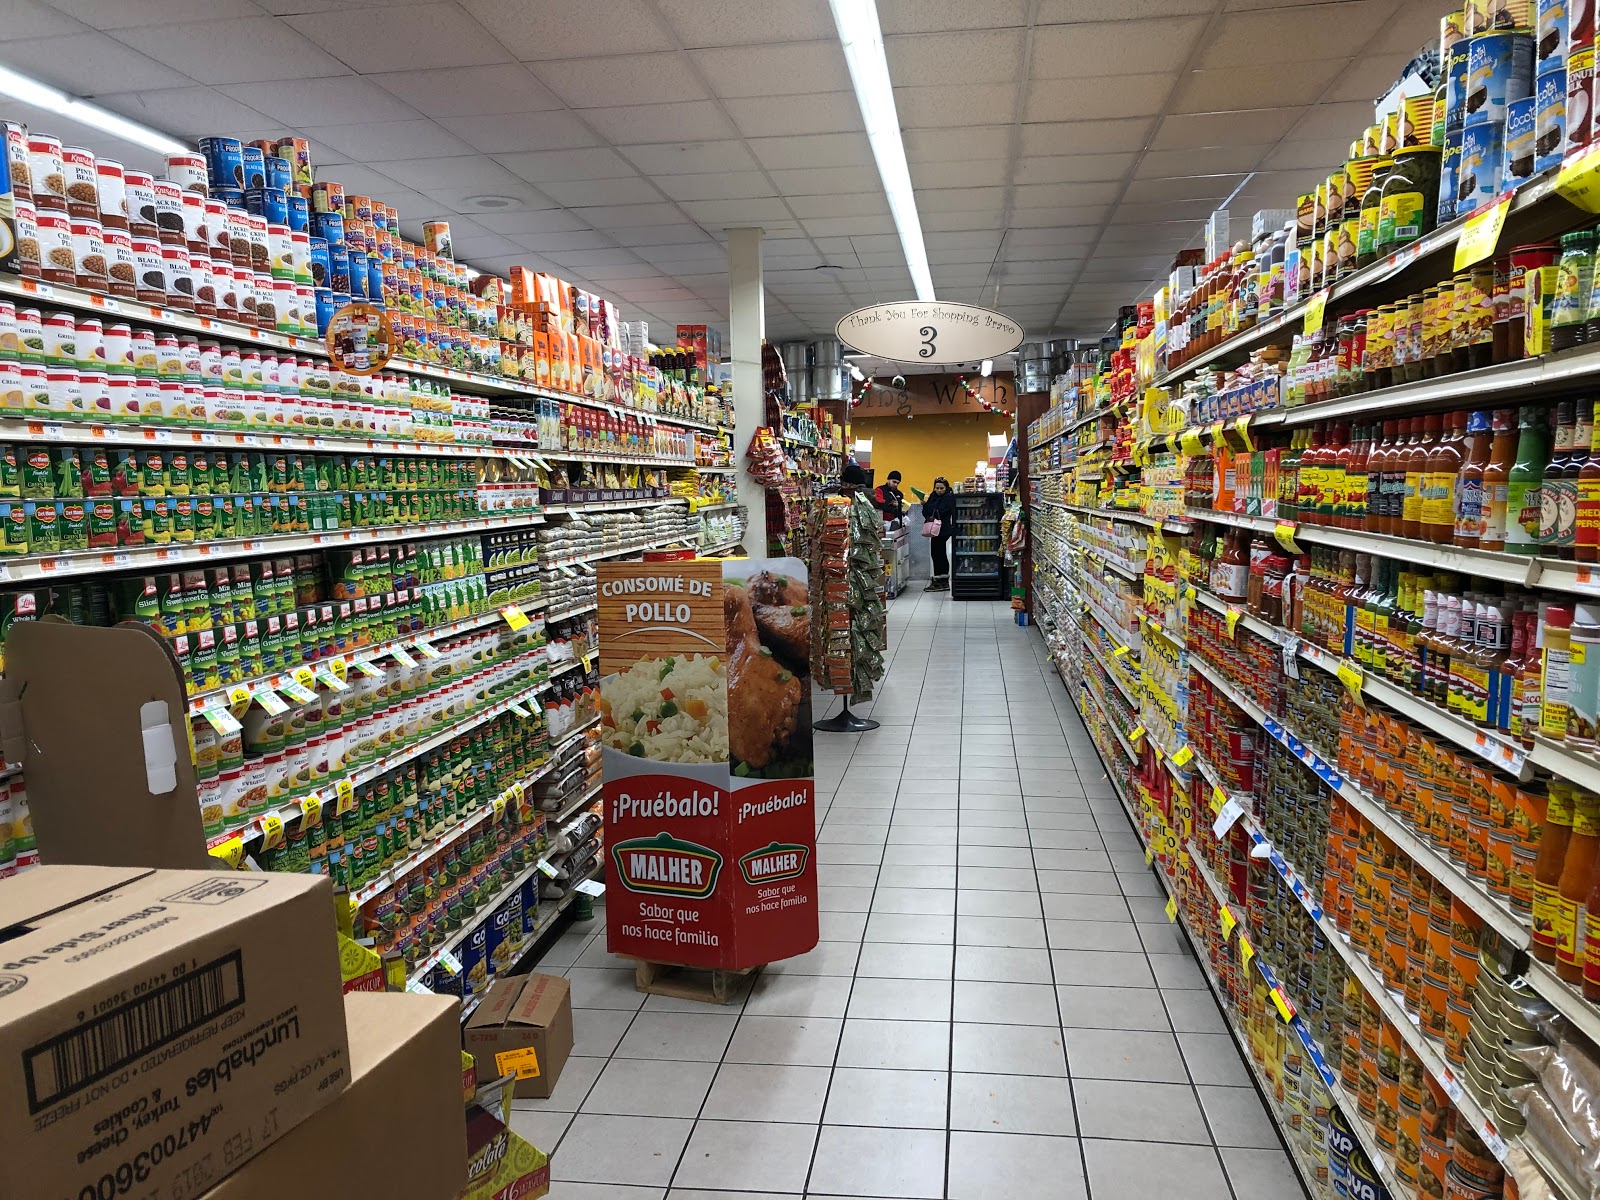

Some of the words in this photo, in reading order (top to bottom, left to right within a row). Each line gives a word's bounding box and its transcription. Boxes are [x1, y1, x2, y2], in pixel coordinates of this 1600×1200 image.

[848, 310, 882, 328] Thank
[885, 309, 906, 322] You
[911, 308, 928, 319] For
[932, 307, 980, 326] Shopping
[985, 315, 1015, 335] Bravo
[918, 326, 938, 358] 3
[602, 575, 684, 597] CONSOMÉ
[689, 580, 713, 597] DE
[626, 602, 691, 623] POLLO
[612, 790, 719, 824] ¡Pruébalo!
[738, 789, 807, 824] ¡Pruébalo!
[630, 853, 703, 885] MALHER
[751, 853, 797, 876] MALHER
[746, 905, 760, 915] nos
[761, 901, 779, 912] hace
[781, 895, 807, 910] familia
[757, 887, 780, 899] Sabor
[781, 885, 796, 896] que
[639, 902, 674, 920] Sabor
[676, 909, 699, 923] que
[622, 924, 642, 938] nos
[645, 926, 672, 941] hace
[675, 928, 719, 947] familia
[221, 1009, 246, 1031] KEEP
[141, 1021, 219, 1072] REFRIGERATED
[186, 1014, 300, 1099] Lunchables
[83, 1079, 109, 1104] NOT
[111, 1071, 129, 1089] DO
[152, 1087, 162, 1101] &
[33, 1096, 81, 1132] FREEZE
[93, 1098, 148, 1137] Cookies
[132, 1095, 181, 1131] Turkey,
[76, 1127, 129, 1166] Cheese
[468, 1133, 507, 1179] colate
